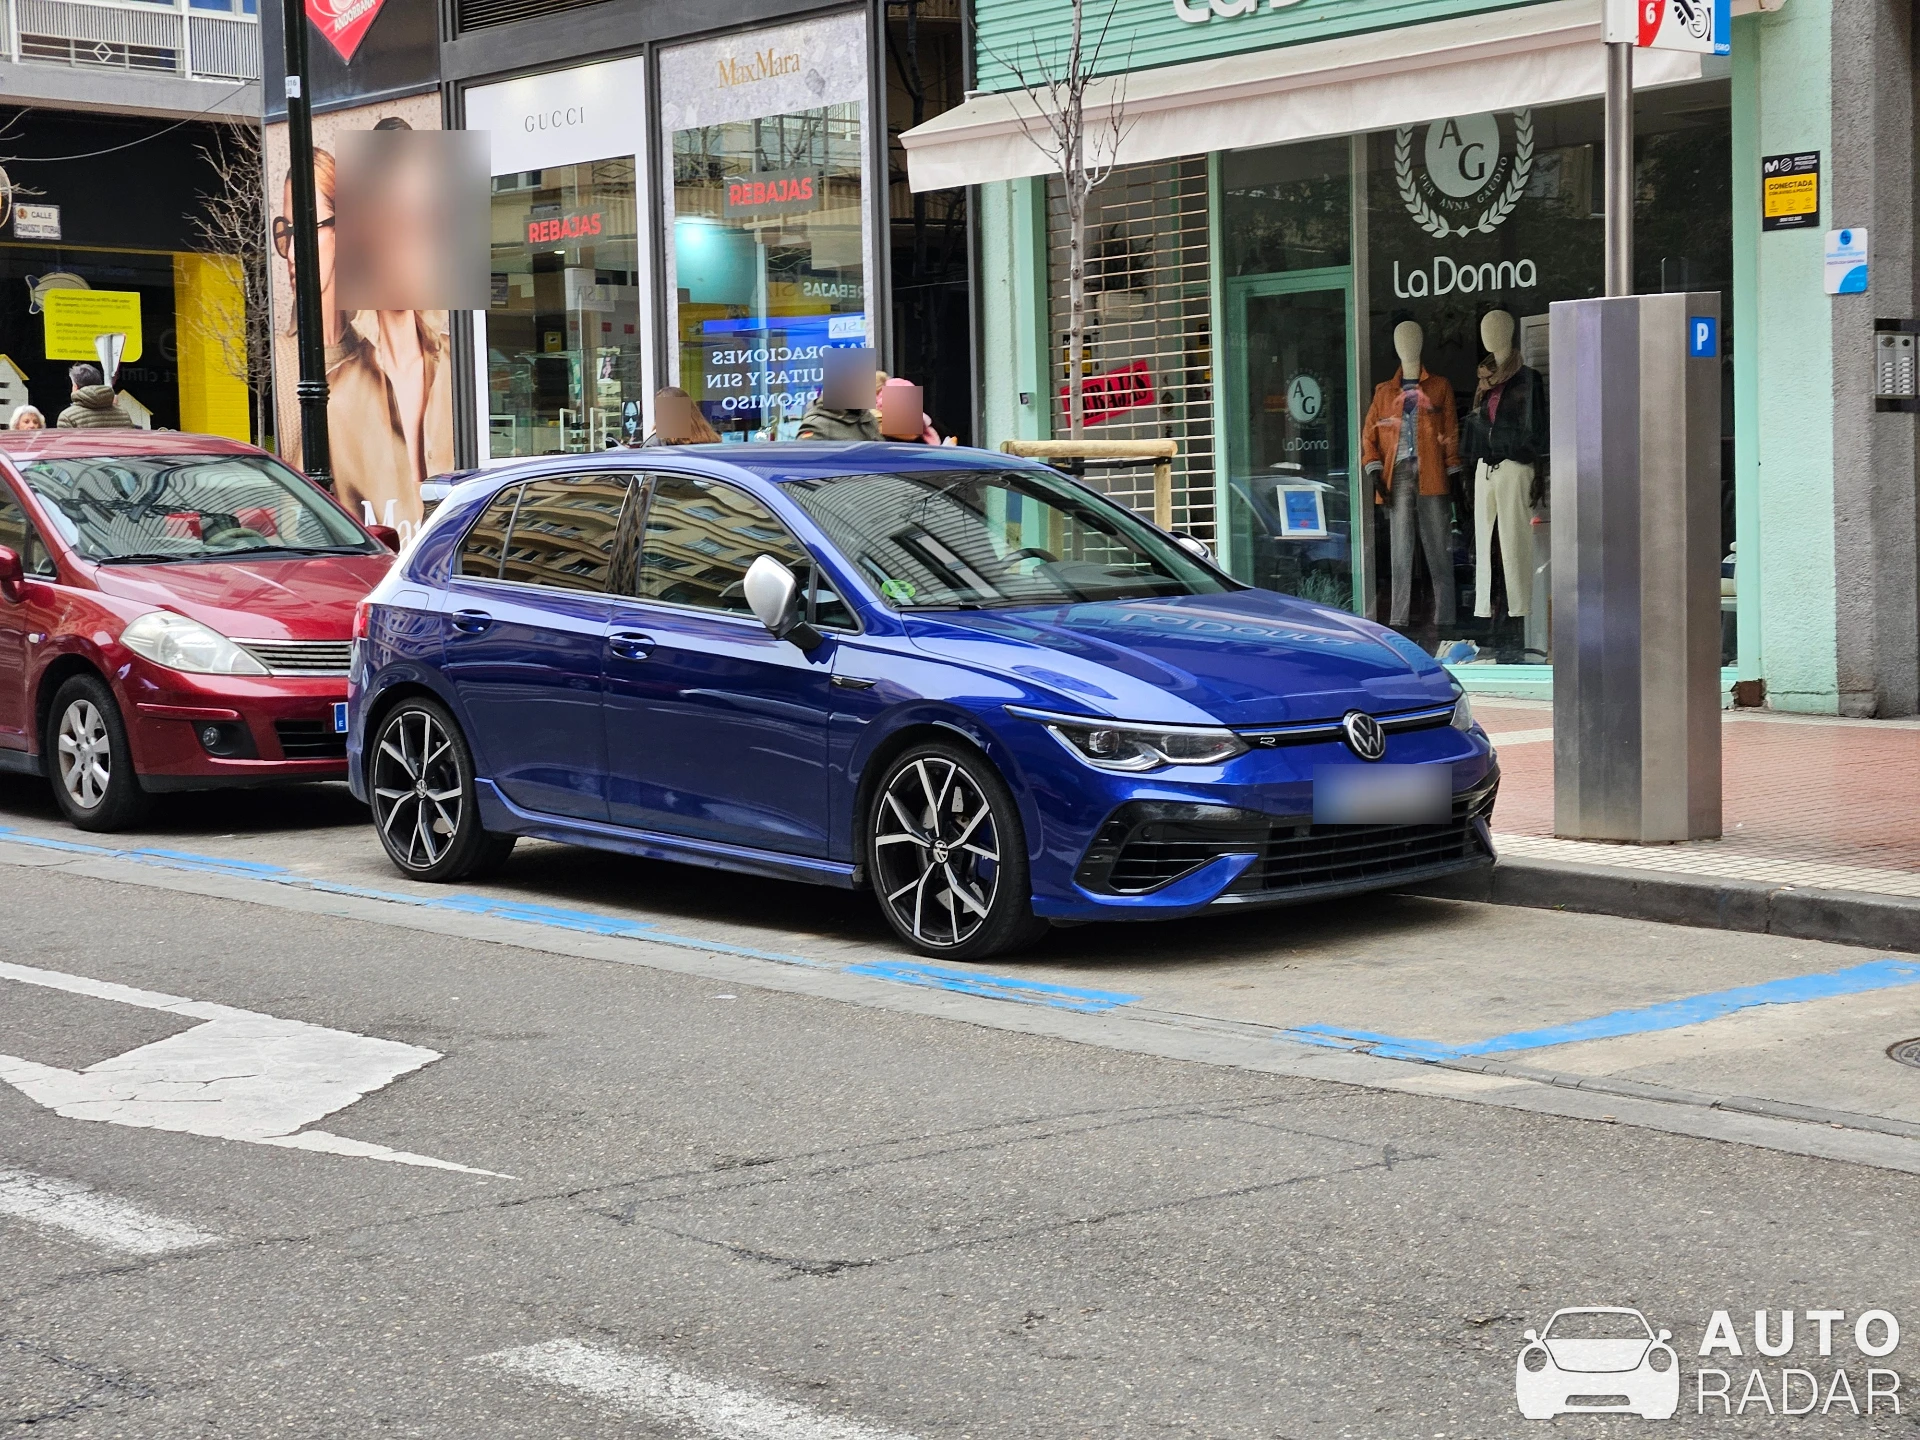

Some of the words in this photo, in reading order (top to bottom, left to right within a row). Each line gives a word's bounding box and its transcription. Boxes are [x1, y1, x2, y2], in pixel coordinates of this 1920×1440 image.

[1645, 2, 1656, 24] 6
[717, 48, 800, 88] MaxMara
[525, 107, 584, 132] GUCCI
[729, 177, 814, 207] REBAJAS
[1419, 173, 1435, 197] PER
[1439, 198, 1470, 211] ANNA
[1477, 156, 1508, 203] GAUDIO
[1769, 180, 1813, 190] CONECTADA
[31, 211, 53, 219] CALLE
[528, 213, 602, 243] REBAJAS
[1697, 322, 1709, 350] P
